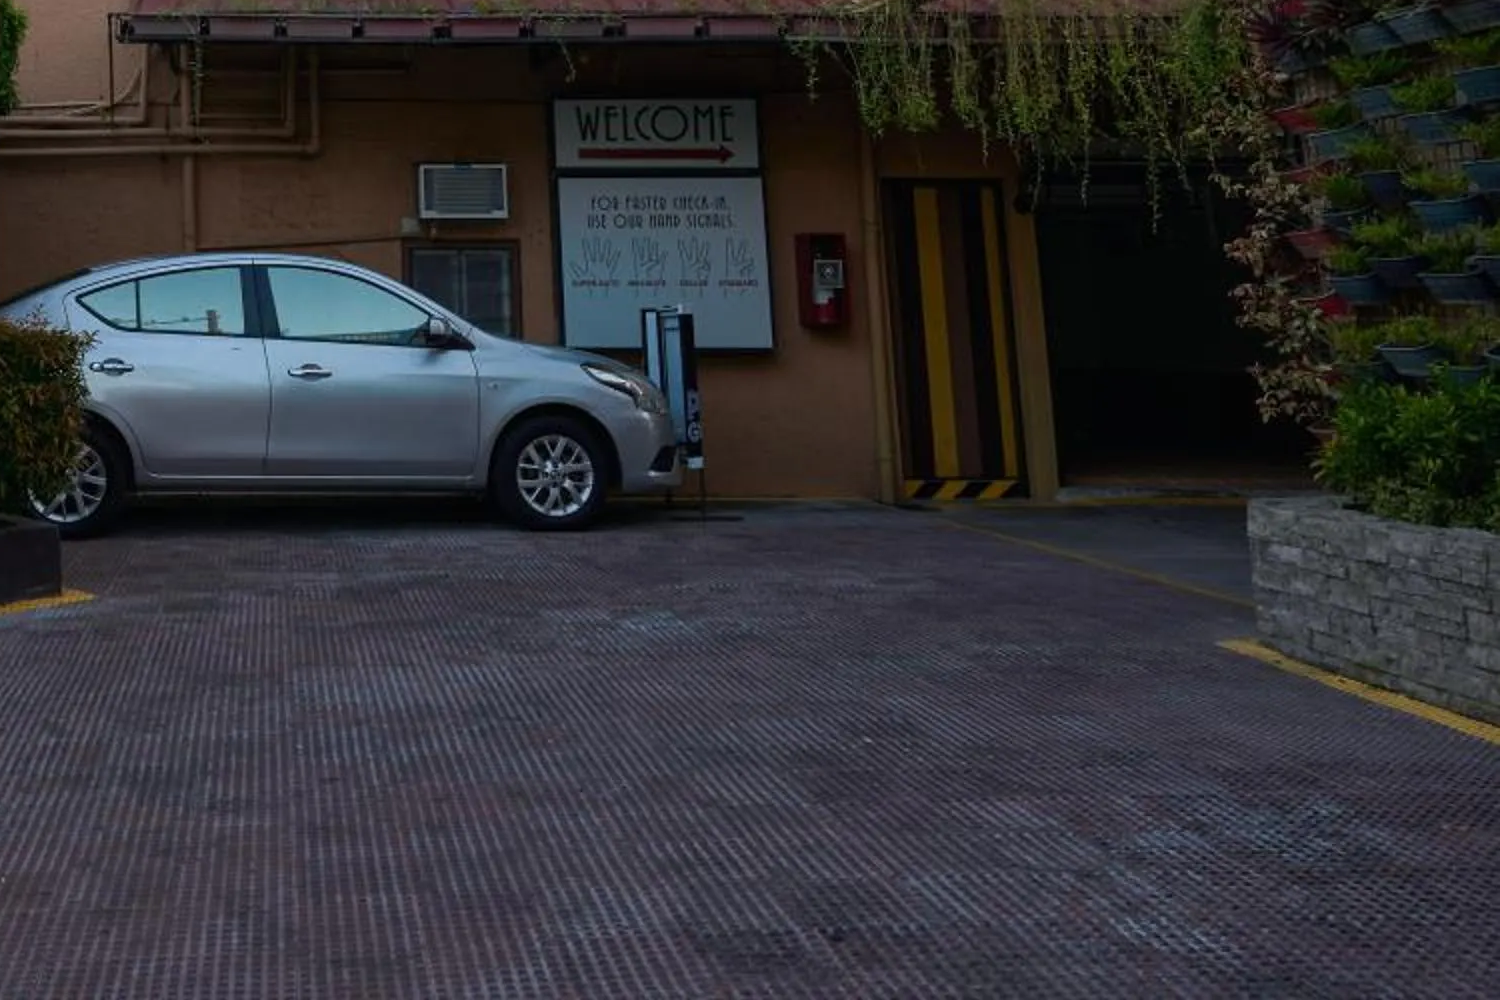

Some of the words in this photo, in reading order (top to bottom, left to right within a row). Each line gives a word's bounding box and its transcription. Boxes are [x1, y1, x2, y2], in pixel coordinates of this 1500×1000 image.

[574, 104, 737, 143] WELCOME
[590, 195, 619, 211] FOR
[625, 195, 667, 211] FASTER
[587, 213, 607, 229] USE
[613, 213, 643, 229] OUR
[649, 213, 681, 229] HAND
